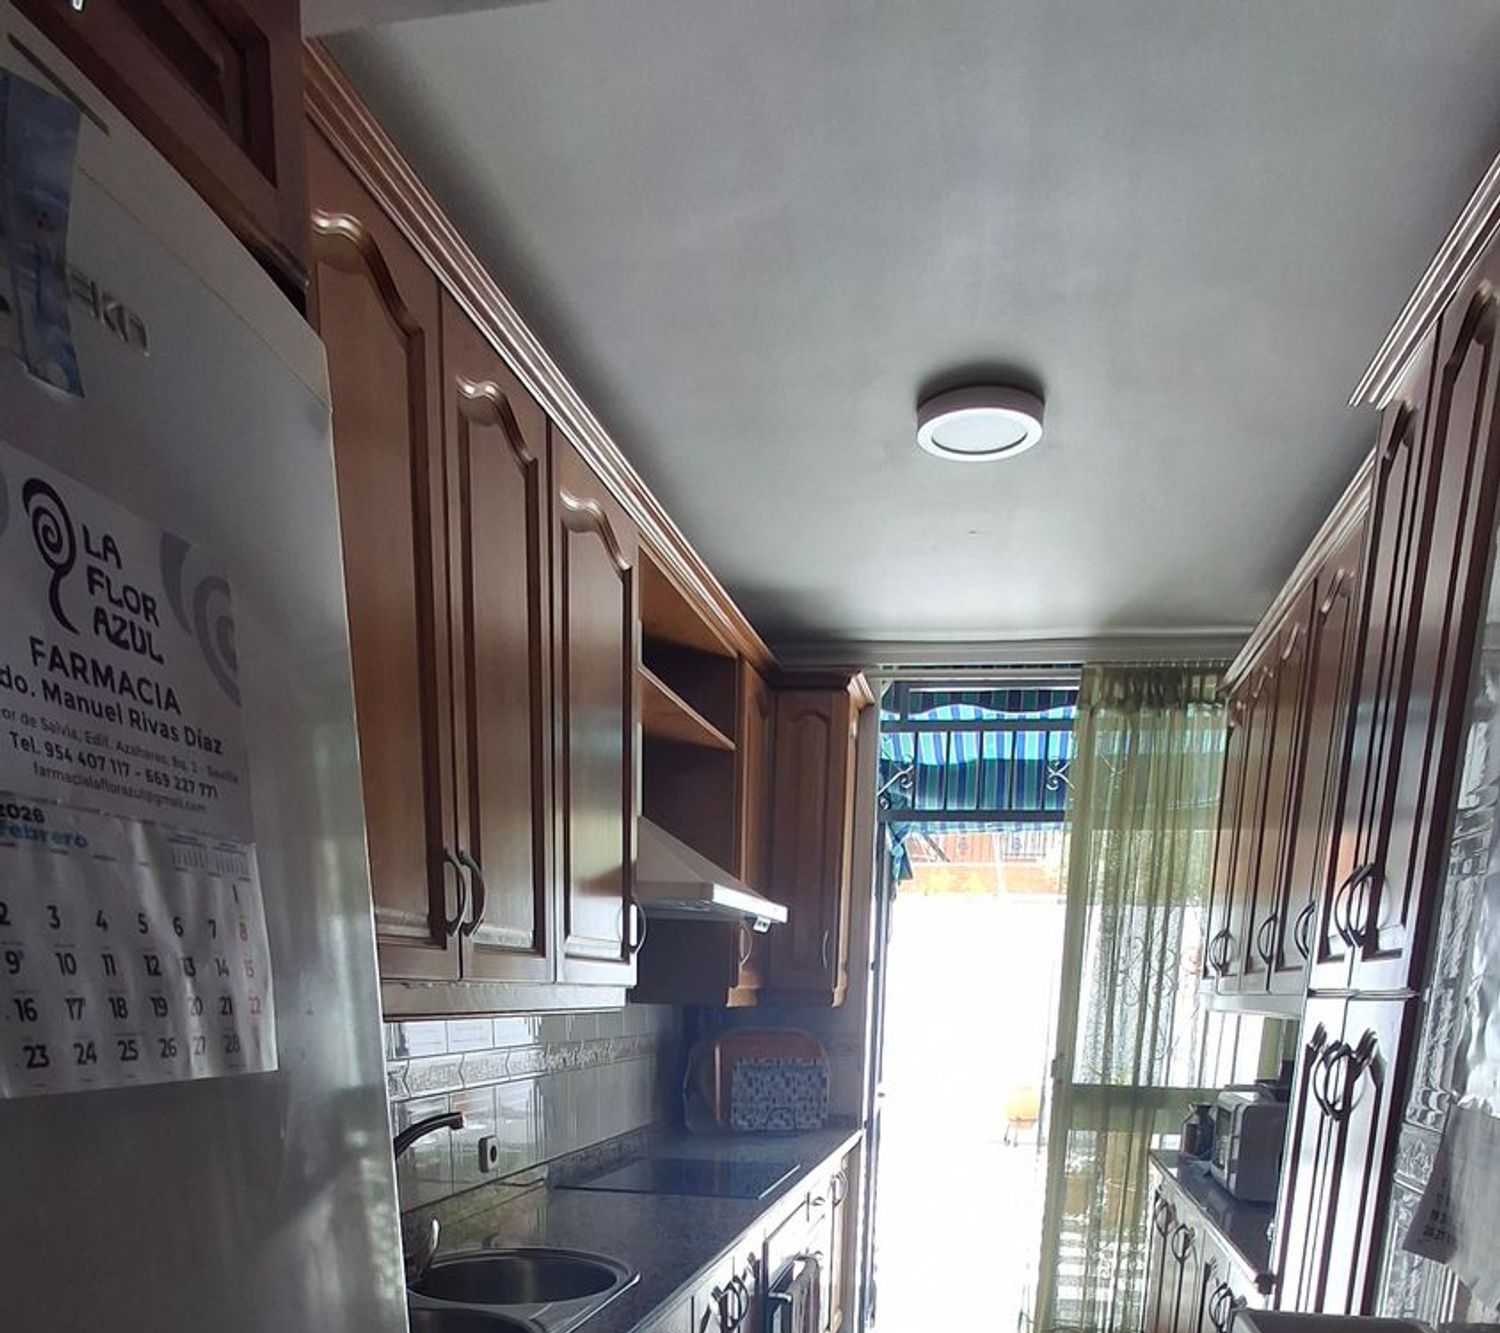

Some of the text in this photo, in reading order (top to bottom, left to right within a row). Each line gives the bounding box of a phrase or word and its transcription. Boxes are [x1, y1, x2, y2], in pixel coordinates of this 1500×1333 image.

[82, 523, 122, 570] LA
[86, 564, 160, 628] FLOR
[93, 606, 165, 665] AZUL
[29, 636, 182, 715] FARMACIA
[42, 678, 123, 725] Manuel
[128, 708, 180, 742] Rivas
[9, 730, 40, 755] Tel.
[44, 741, 73, 762] 954
[78, 751, 106, 771] 407
[110, 758, 129, 778] 117
[145, 768, 170, 788] 669
[174, 775, 195, 794] 227
[232, 884, 239, 904] 1
[0, 901, 249, 942] 2 3 4 5 6 7 8
[5, 949, 21, 976] 9
[55, 952, 77, 976] 10
[101, 953, 117, 977] 11
[142, 954, 162, 977] 12
[182, 956, 197, 978] 13
[214, 957, 230, 978] 14
[13, 996, 38, 1022] 16
[64, 996, 86, 1021] 17
[108, 996, 128, 1020] 18
[149, 995, 168, 1018] 19
[218, 995, 234, 1016] 21
[22, 1033, 241, 1069] 23 24 25 26 27 28
